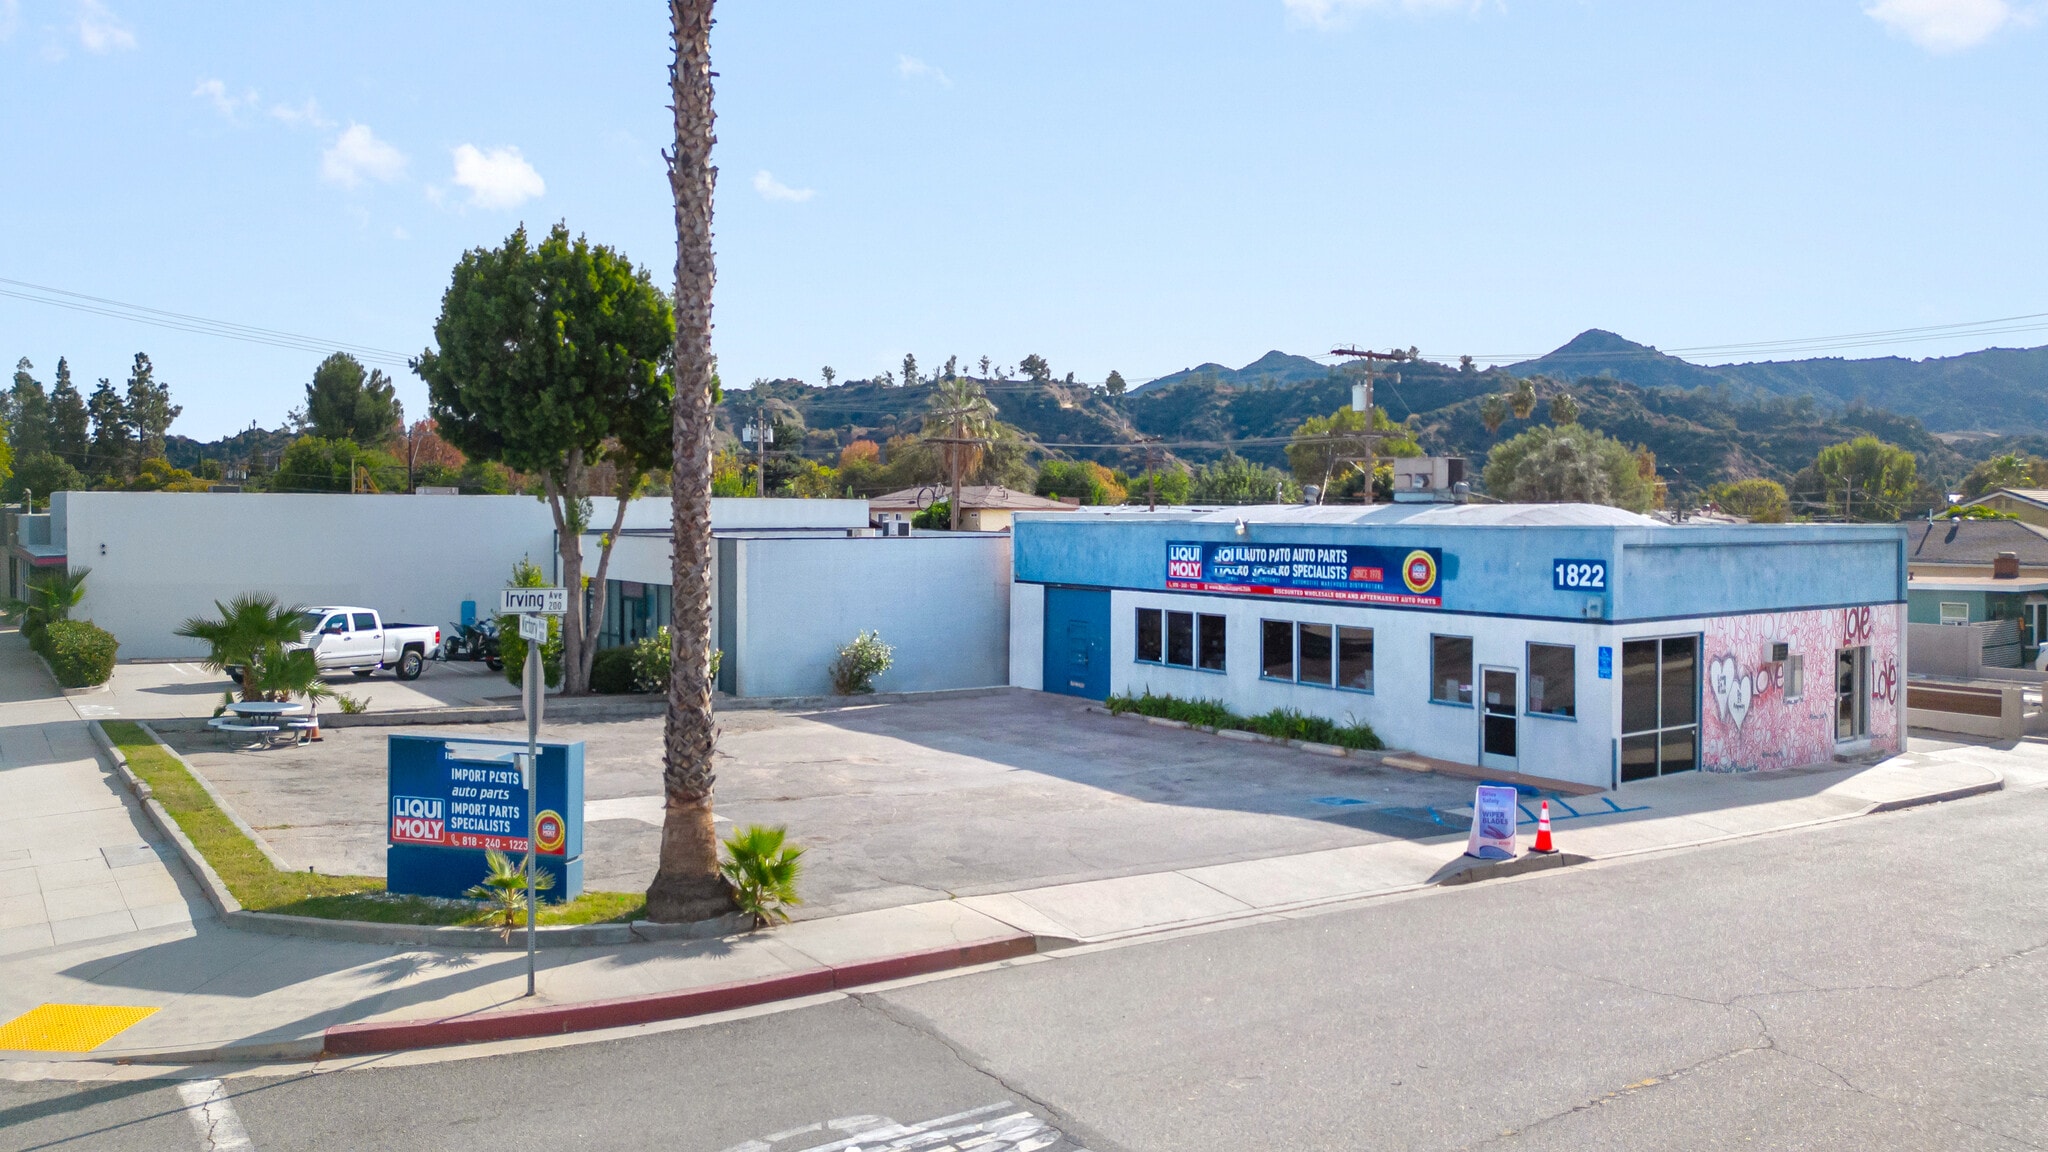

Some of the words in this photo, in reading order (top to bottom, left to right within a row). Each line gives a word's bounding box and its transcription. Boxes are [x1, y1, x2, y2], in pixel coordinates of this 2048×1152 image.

[1170, 547, 1200, 561] LIQUI
[1293, 548, 1315, 562] AUTO
[1317, 549, 1348, 564] PARTS
[1170, 562, 1201, 577] MOLY
[1292, 564, 1348, 580] SPECIALISTS
[1555, 564, 1605, 588] 1822
[506, 591, 544, 610] Irving
[548, 591, 563, 600] Ave
[1273, 588, 1304, 596] DISCOUNTED
[1304, 590, 1334, 598] WHOLESALE
[1360, 593, 1400, 602] AFTERMARKET
[1400, 596, 1416, 604] AUTO
[1417, 597, 1437, 605] PARTS
[548, 601, 562, 610] 200
[451, 768, 486, 783] IMPORT
[451, 785, 477, 798] auto
[479, 788, 510, 801] parts
[396, 798, 442, 819] LIQUI
[451, 803, 486, 817] IMPORT
[489, 805, 520, 820] PARTS
[1482, 811, 1505, 819] WIPER
[396, 820, 444, 840] MOLY
[451, 818, 510, 833] SPECIALISTS
[462, 835, 477, 846] 818
[485, 837, 501, 848] 240
[509, 839, 528, 851] 1223
